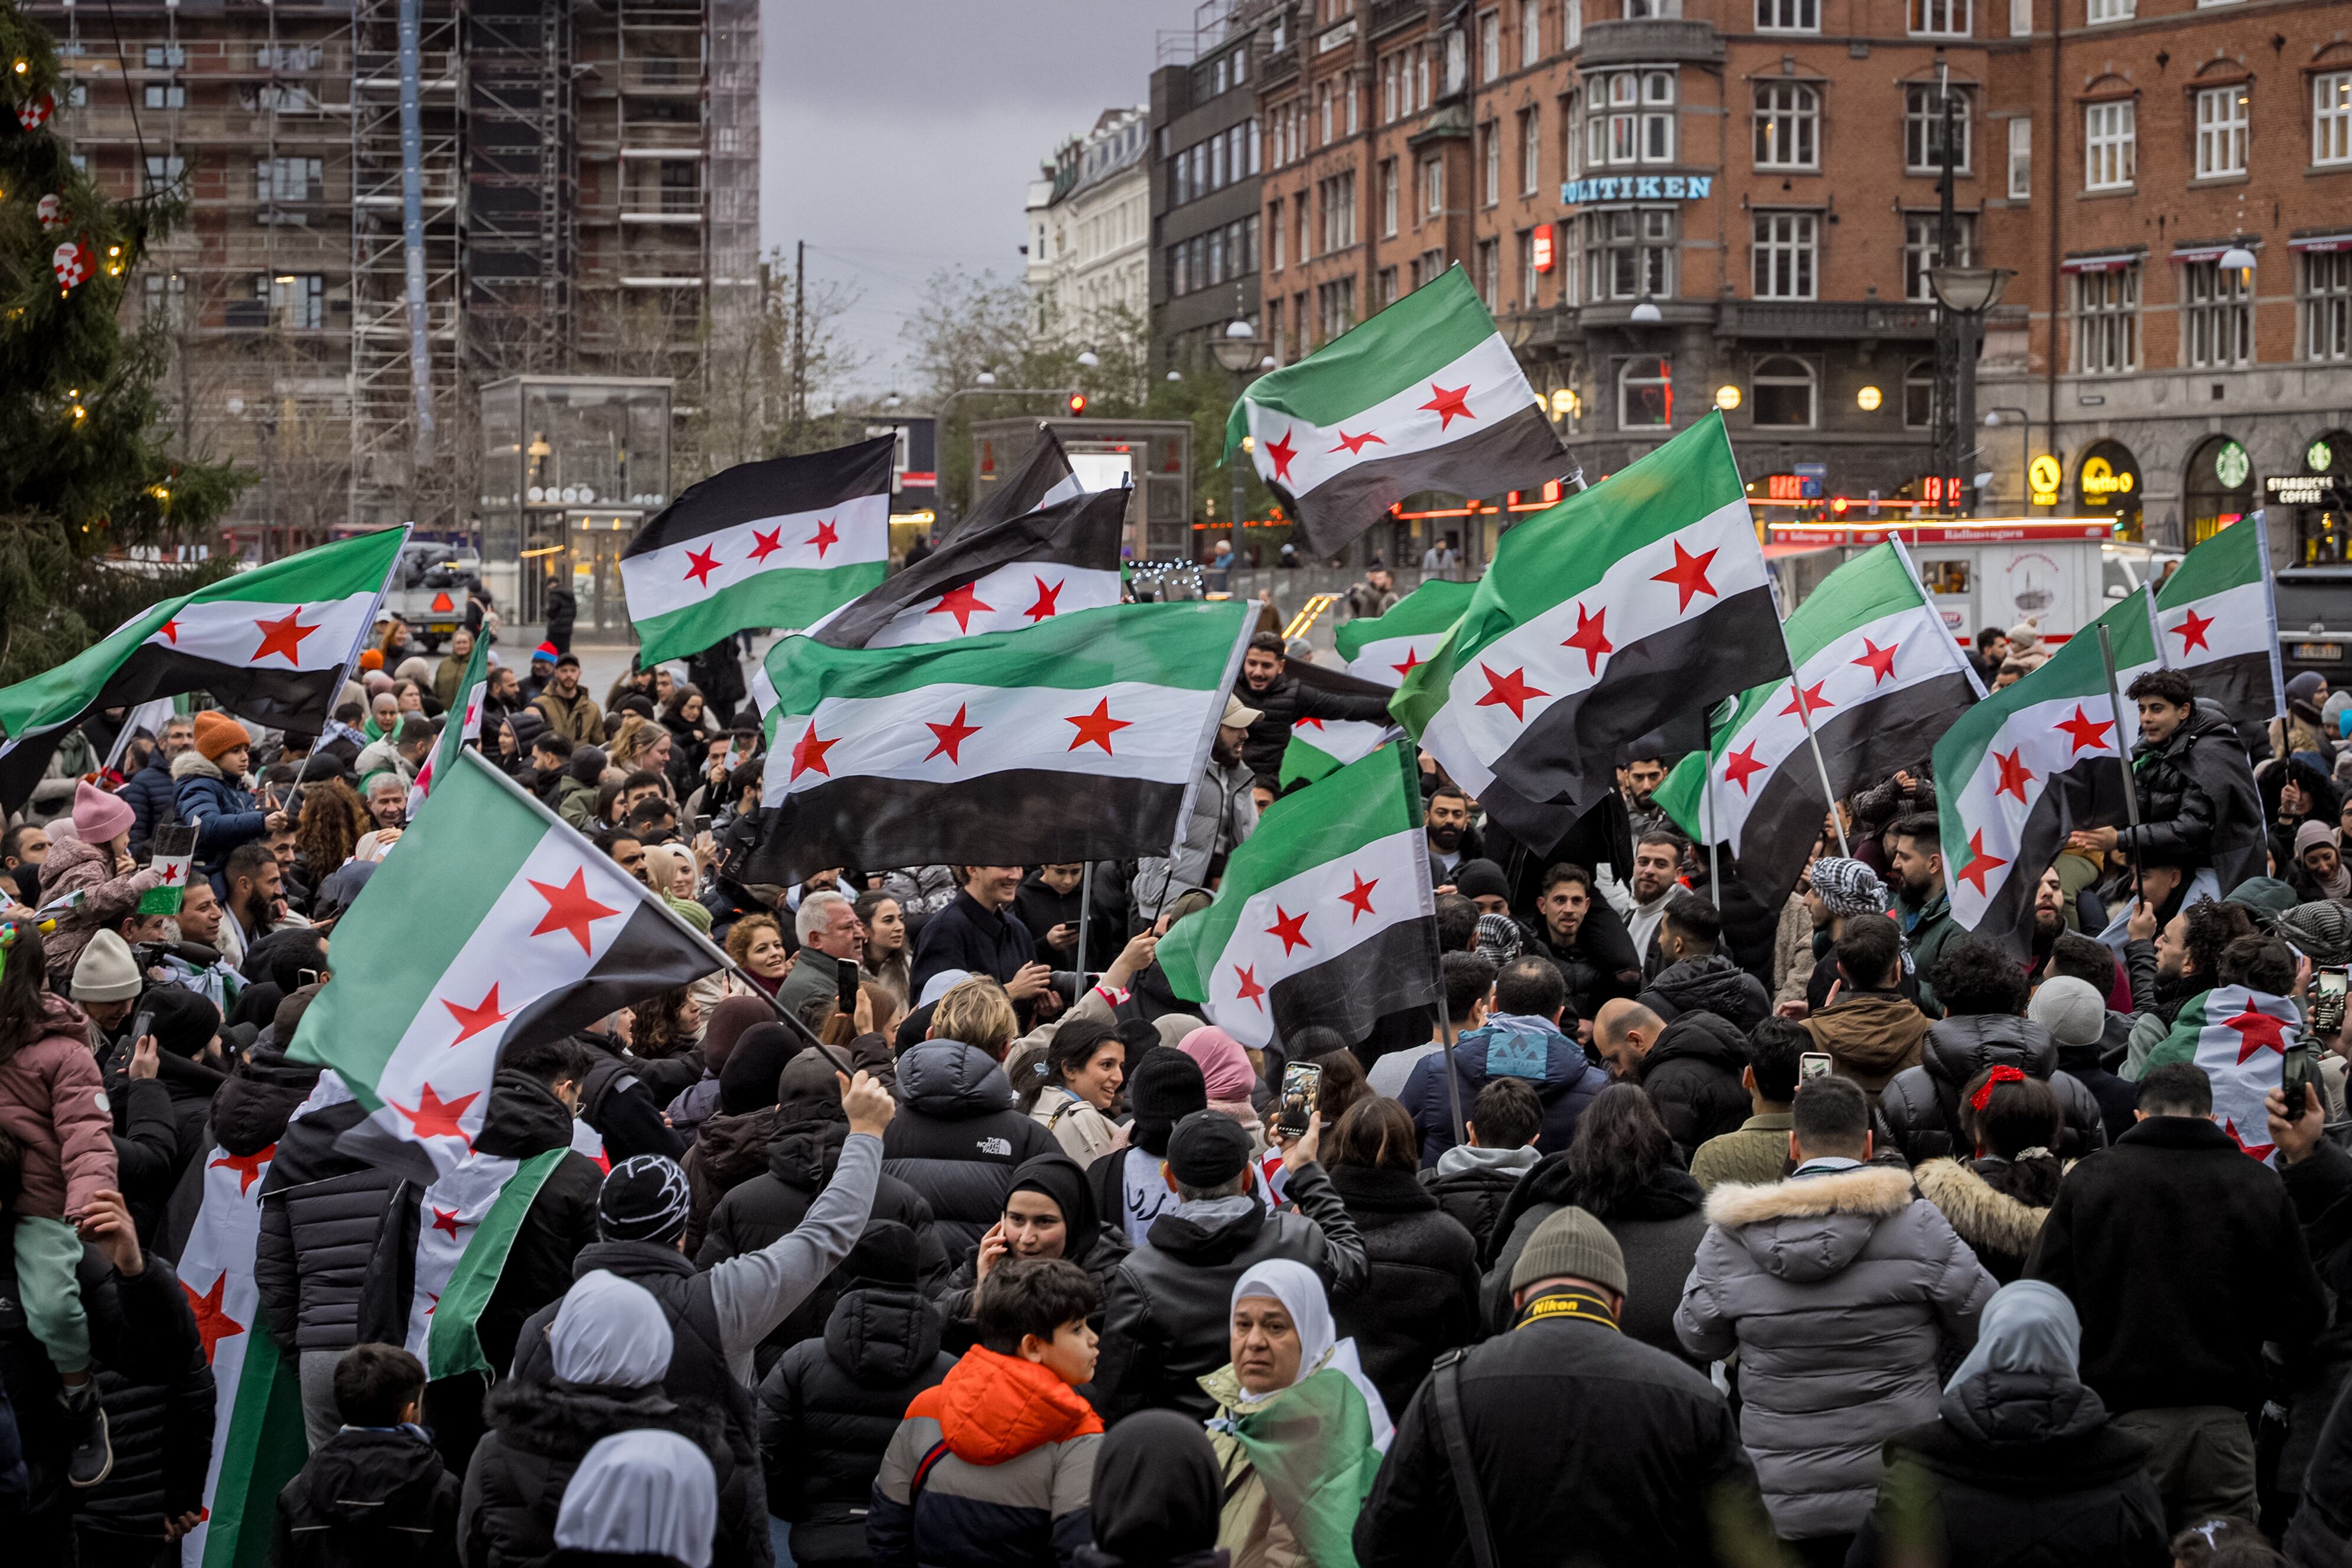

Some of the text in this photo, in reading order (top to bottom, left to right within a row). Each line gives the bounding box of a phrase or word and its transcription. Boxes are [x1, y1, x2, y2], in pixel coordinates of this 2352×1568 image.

[1561, 177, 1711, 204] POLITIKEN
[2267, 476, 2334, 491] STARBUCKS
[2279, 490, 2322, 504] COFFEE
[1532, 1299, 1578, 1316] Nikon
